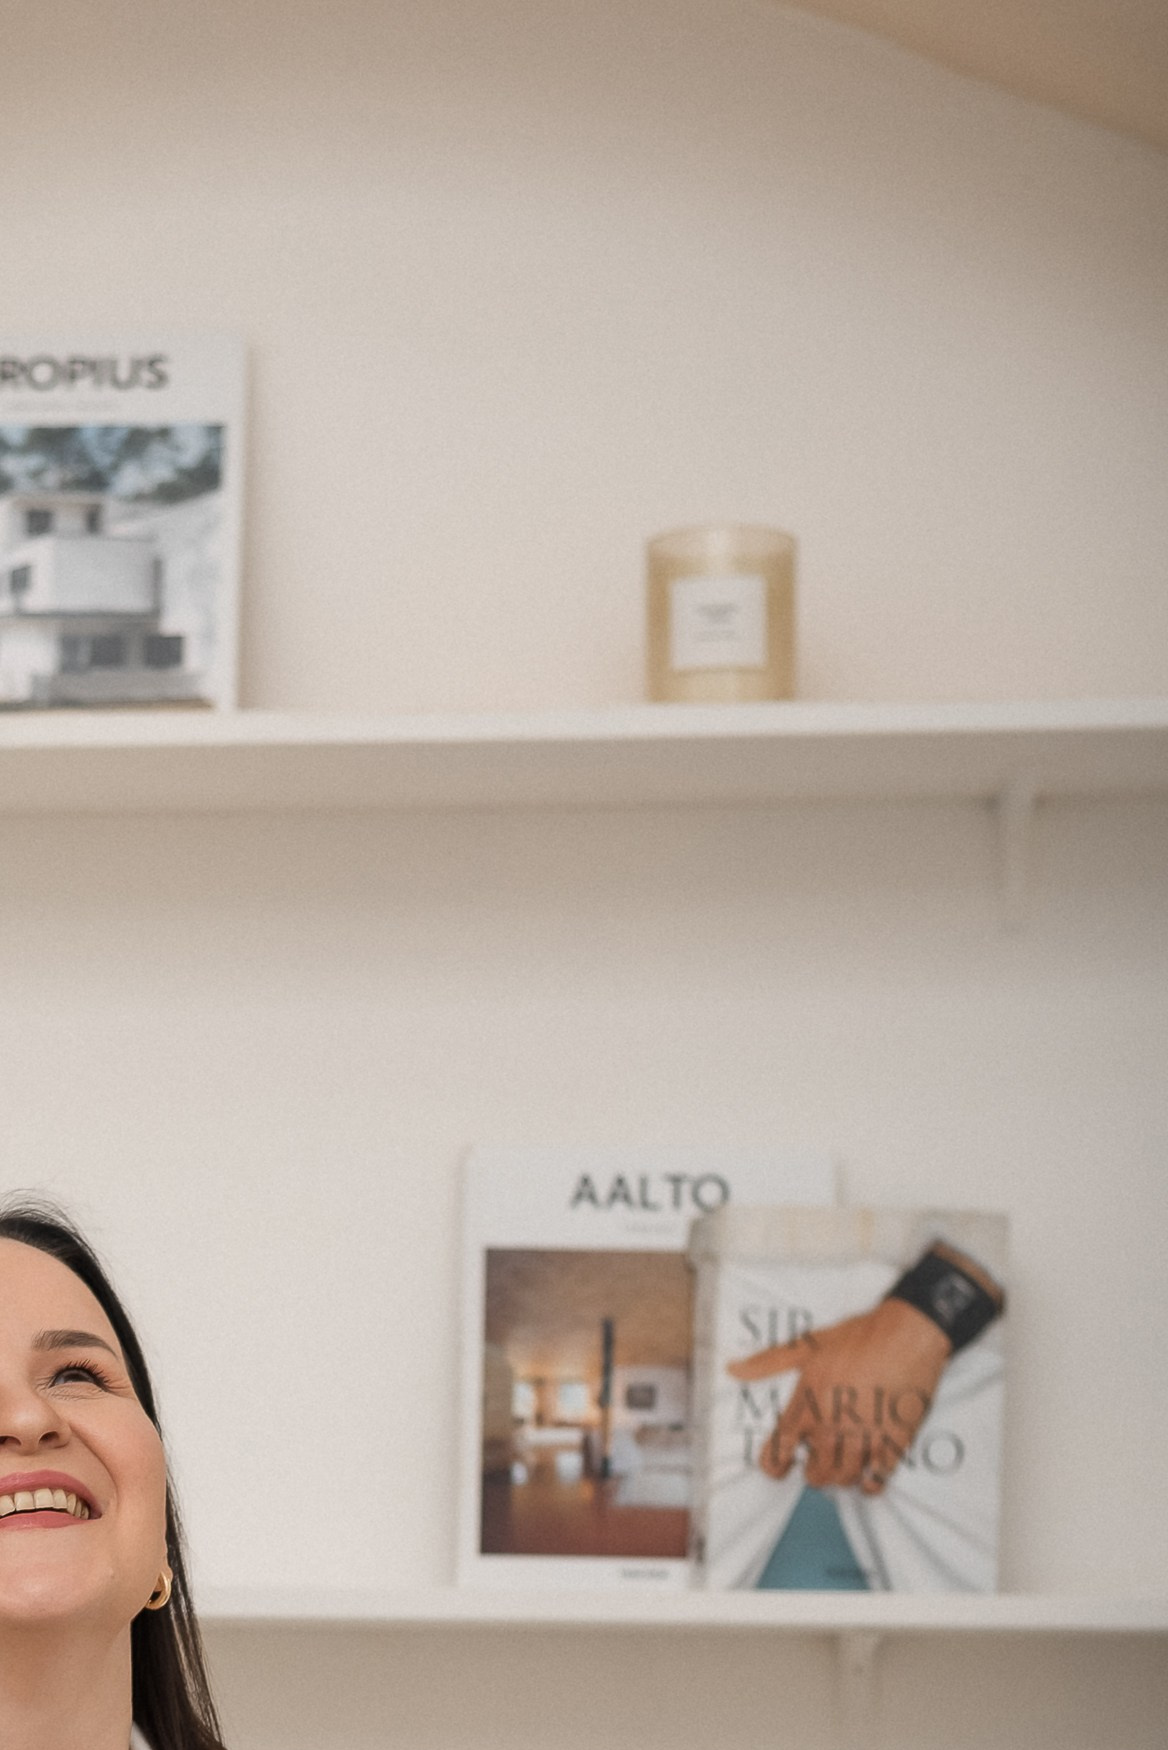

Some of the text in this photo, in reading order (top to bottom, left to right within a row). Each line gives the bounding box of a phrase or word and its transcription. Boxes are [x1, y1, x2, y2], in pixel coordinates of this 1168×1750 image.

[569, 1174, 730, 1214] AALTO
[736, 1303, 821, 1351] SIR
[732, 1384, 931, 1427] MARIO
